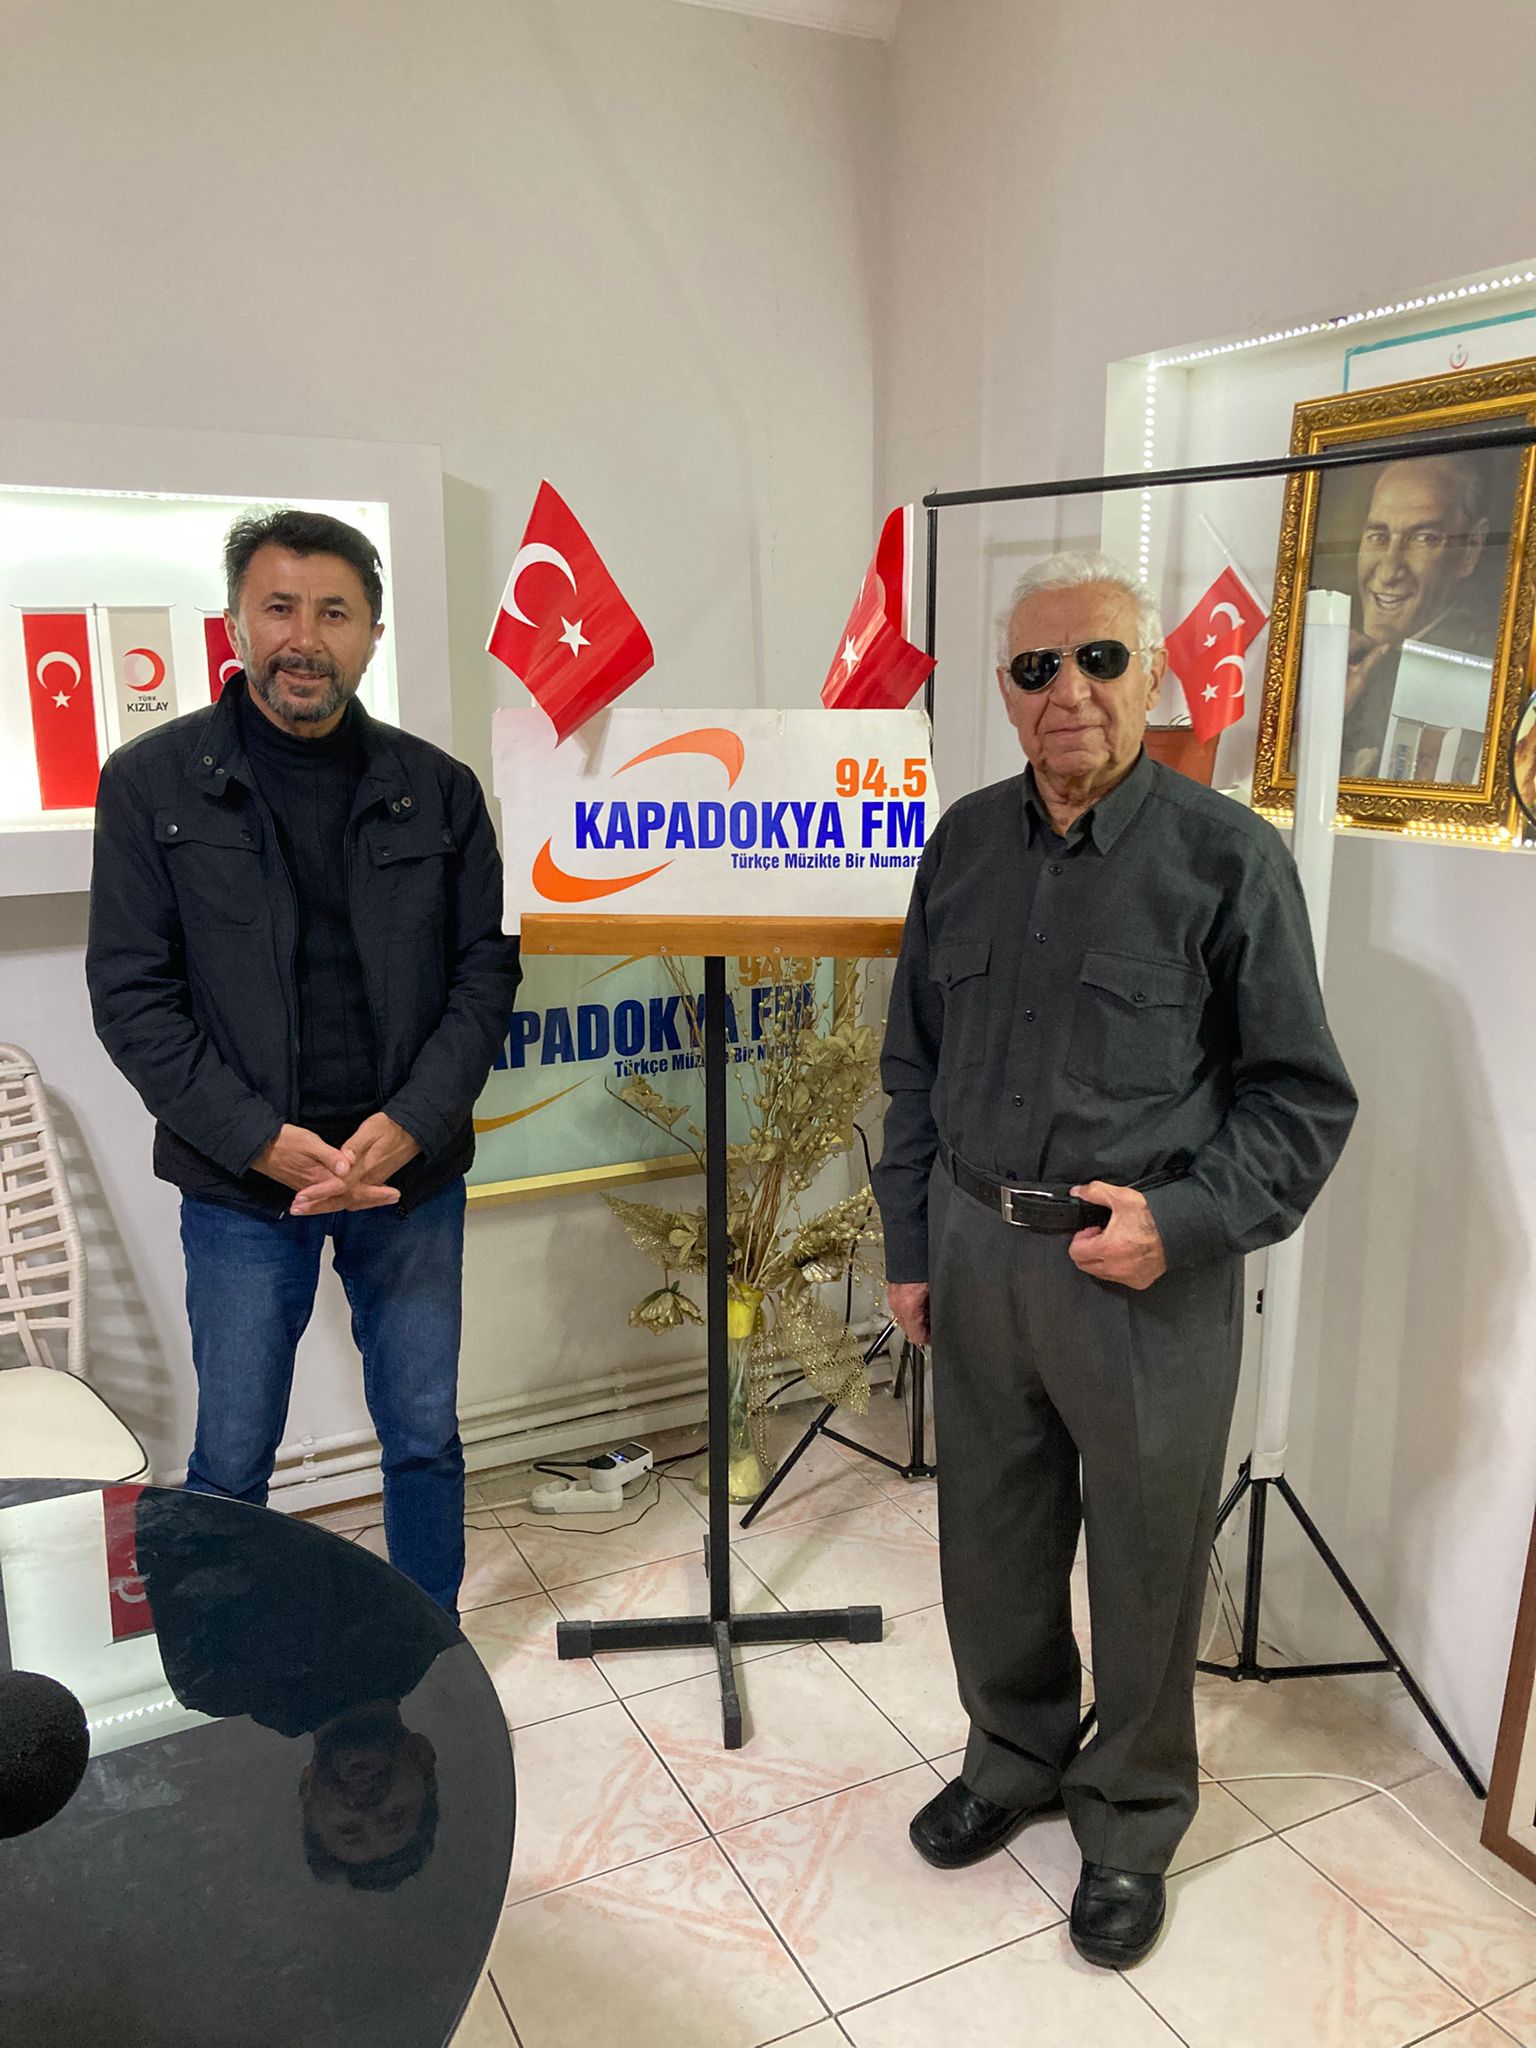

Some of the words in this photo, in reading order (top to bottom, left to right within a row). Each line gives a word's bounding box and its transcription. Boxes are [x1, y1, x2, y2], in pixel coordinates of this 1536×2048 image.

[126, 701, 169, 713] KIZILAY
[835, 757, 927, 798] 94.5
[575, 800, 846, 850] KAPADOKYA
[861, 801, 925, 849] FM
[731, 853, 780, 871] Türkçe
[784, 854, 841, 869] Müzikte
[845, 853, 866, 868] Bir
